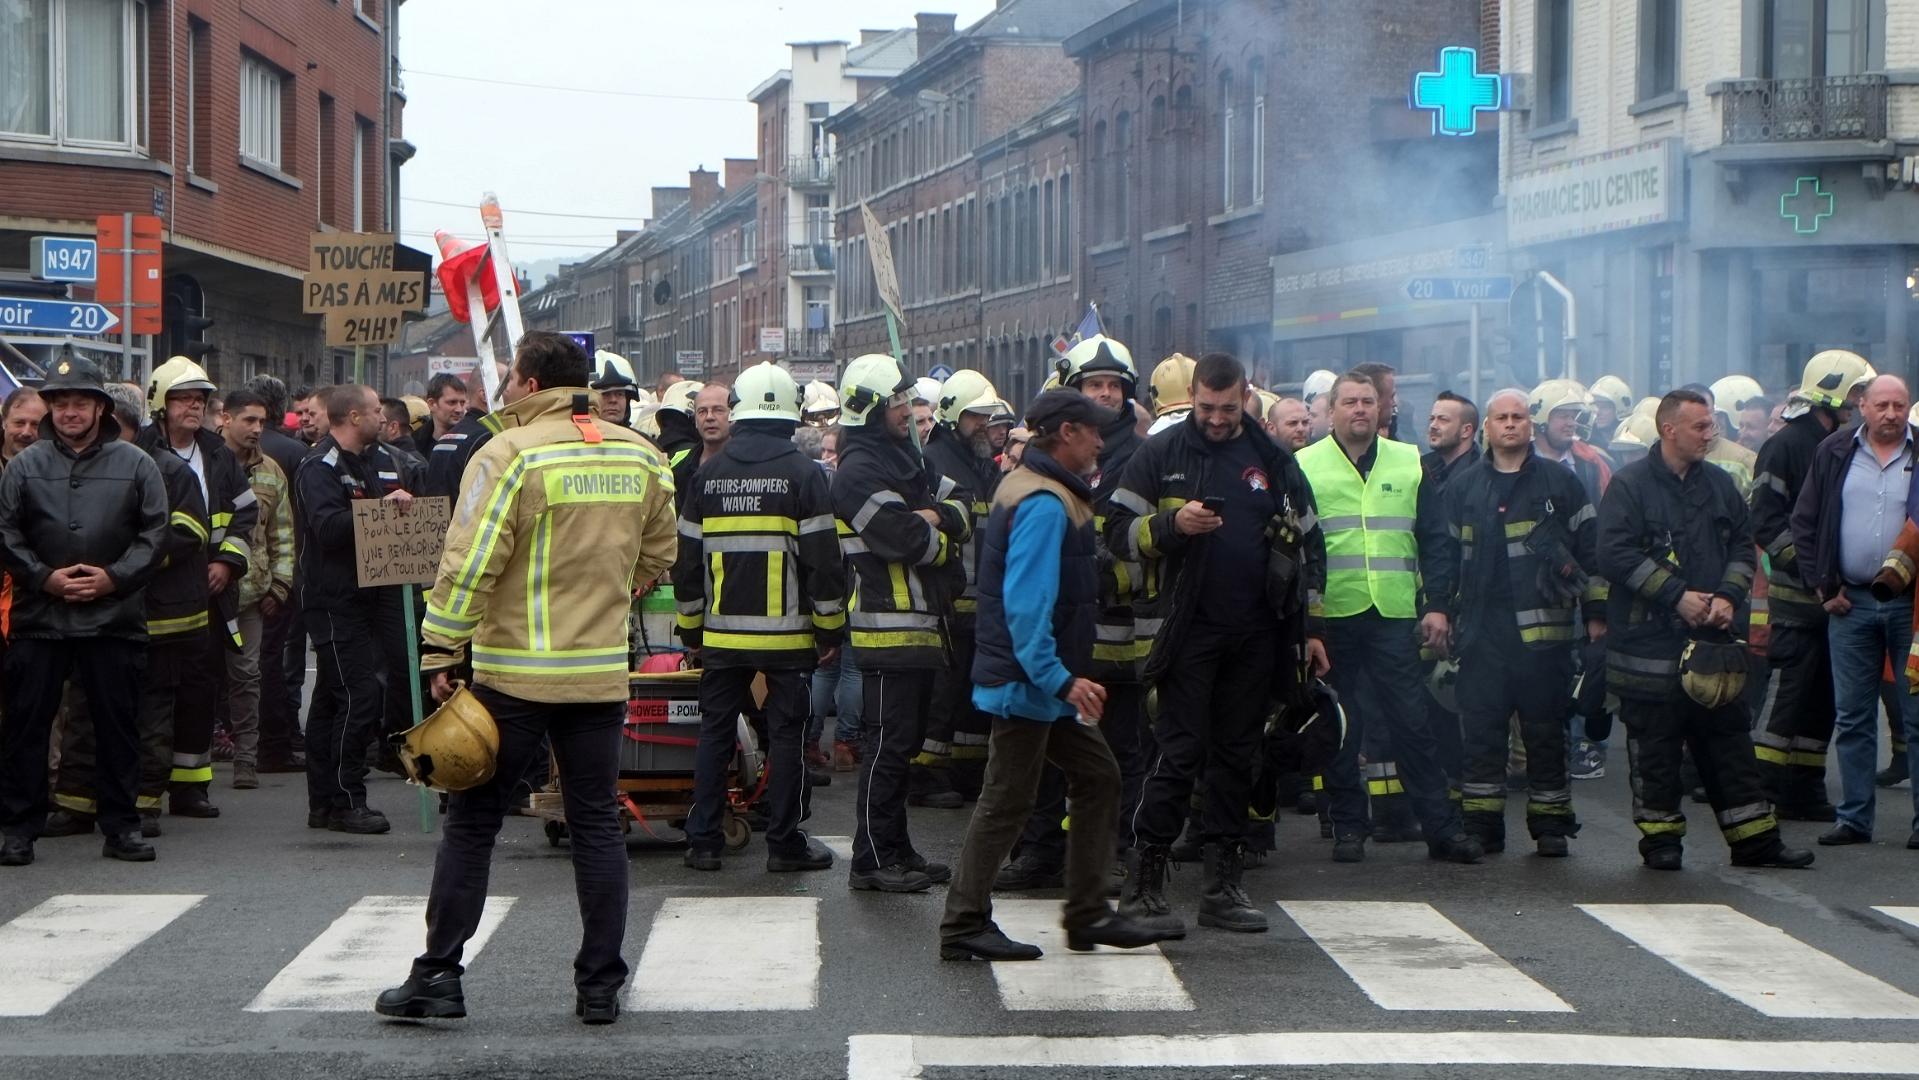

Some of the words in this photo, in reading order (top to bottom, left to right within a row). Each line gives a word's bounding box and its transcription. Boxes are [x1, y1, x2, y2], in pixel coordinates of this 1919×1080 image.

[1512, 183, 1580, 225] PHARMACIE
[1583, 180, 1600, 213] DU
[1606, 166, 1658, 207] CENTRE
[48, 248, 92, 270] N947
[314, 244, 393, 271] TOUCHE
[309, 281, 349, 308] PAS
[375, 280, 421, 305] MES
[1413, 280, 1433, 298] 20
[1452, 280, 1491, 298] Yvoir
[70, 306, 98, 329] 20
[344, 316, 399, 342] 24H!
[562, 473, 642, 496] POMPIERS
[722, 495, 762, 512] WAVRE
[371, 508, 386, 522] DE
[363, 524, 391, 541] POUR
[395, 522, 411, 536] LE
[361, 543, 383, 564] UNE
[363, 563, 391, 580] POUR
[393, 562, 415, 576] TOUS
